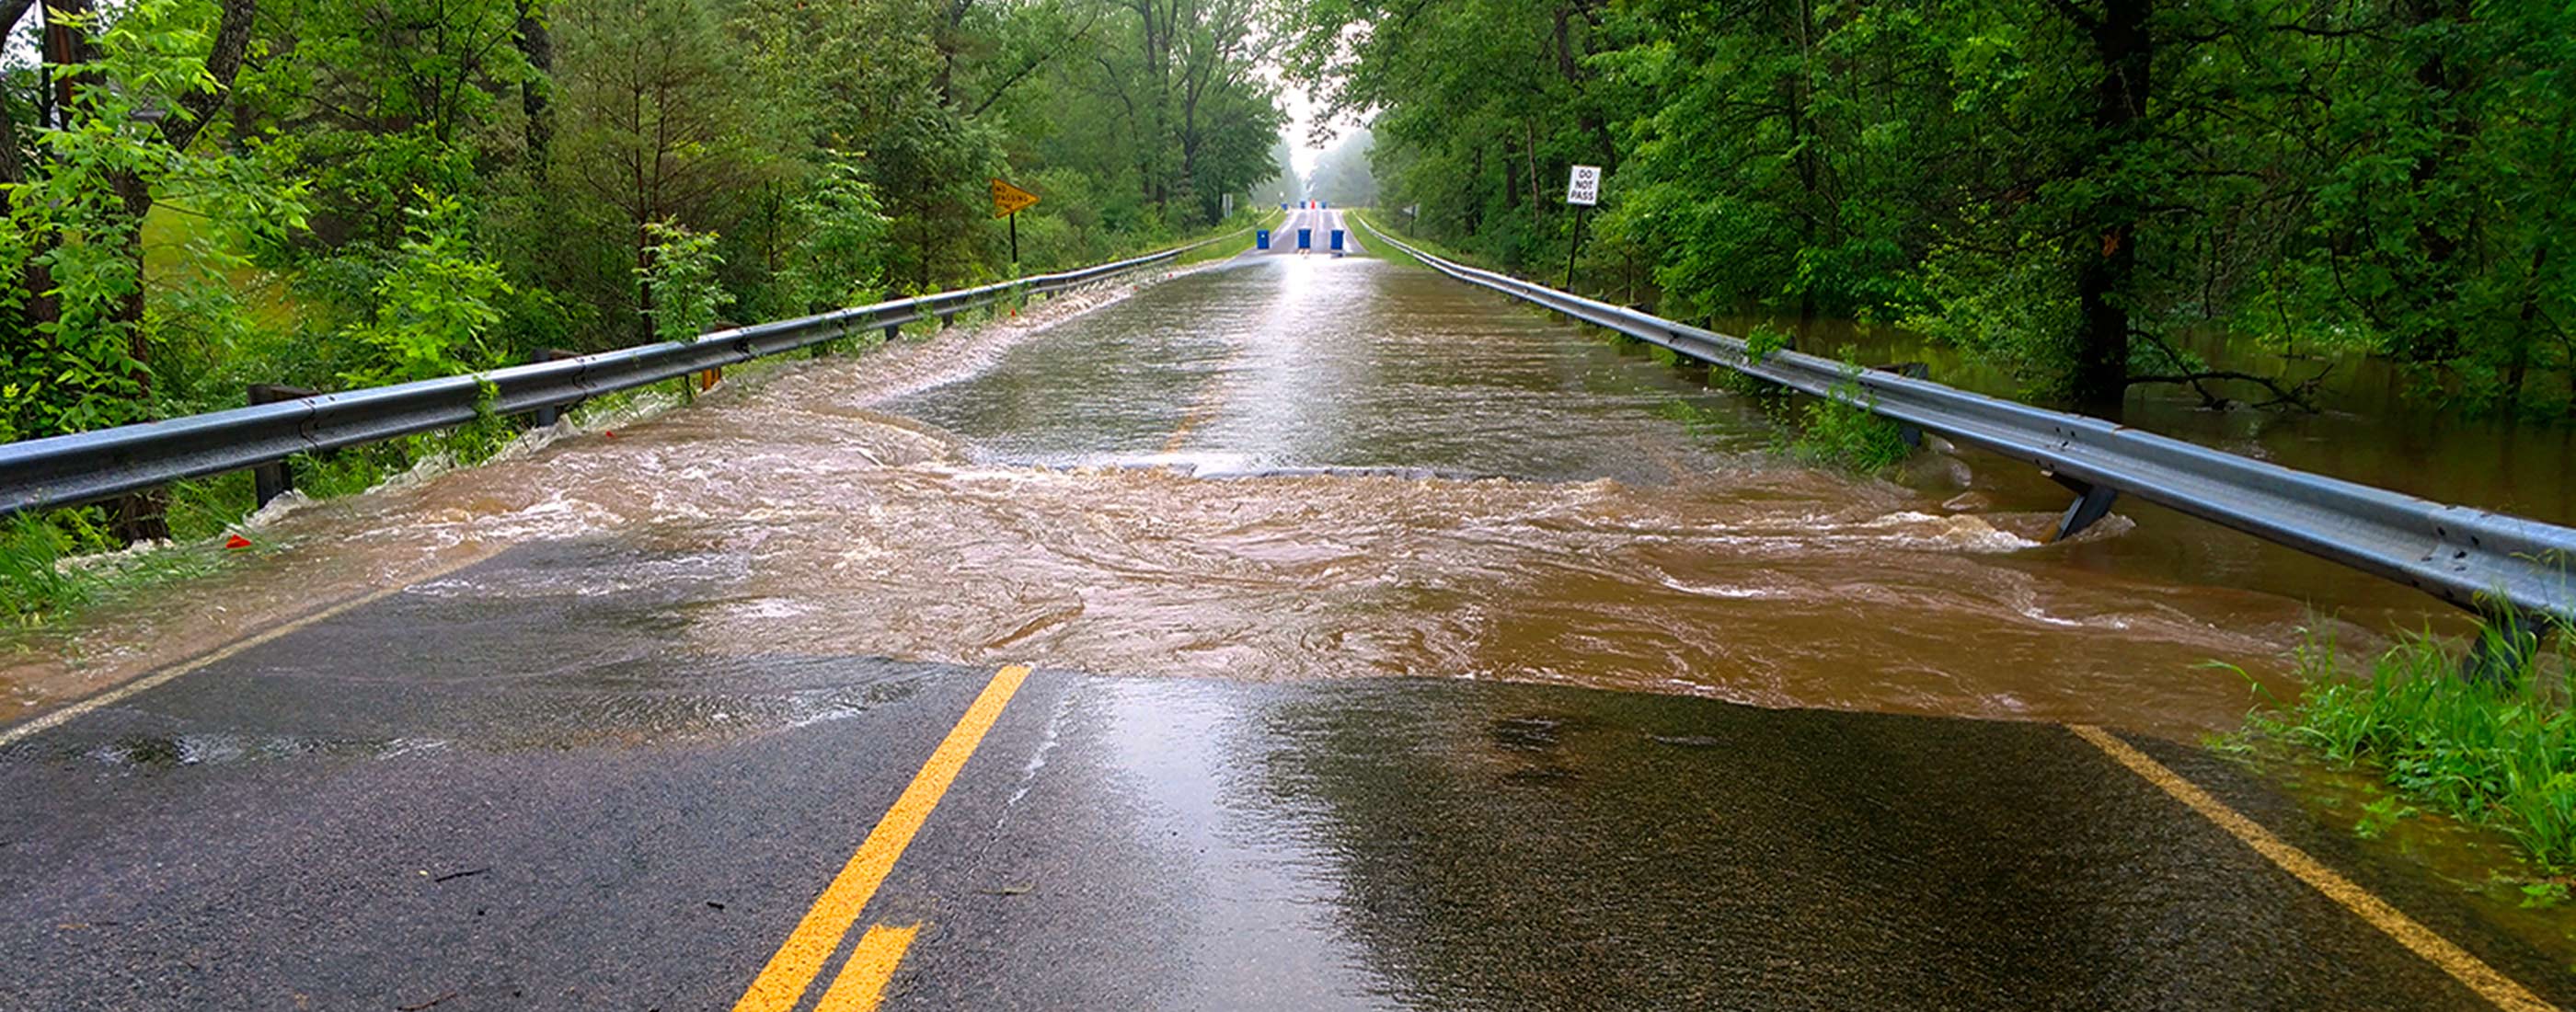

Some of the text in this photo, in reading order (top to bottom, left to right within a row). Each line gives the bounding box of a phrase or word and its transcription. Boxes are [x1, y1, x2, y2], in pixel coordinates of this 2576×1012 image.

[1579, 169, 1593, 178] DO
[1575, 180, 1593, 190] NOT
[1570, 190, 1593, 201] PASS
